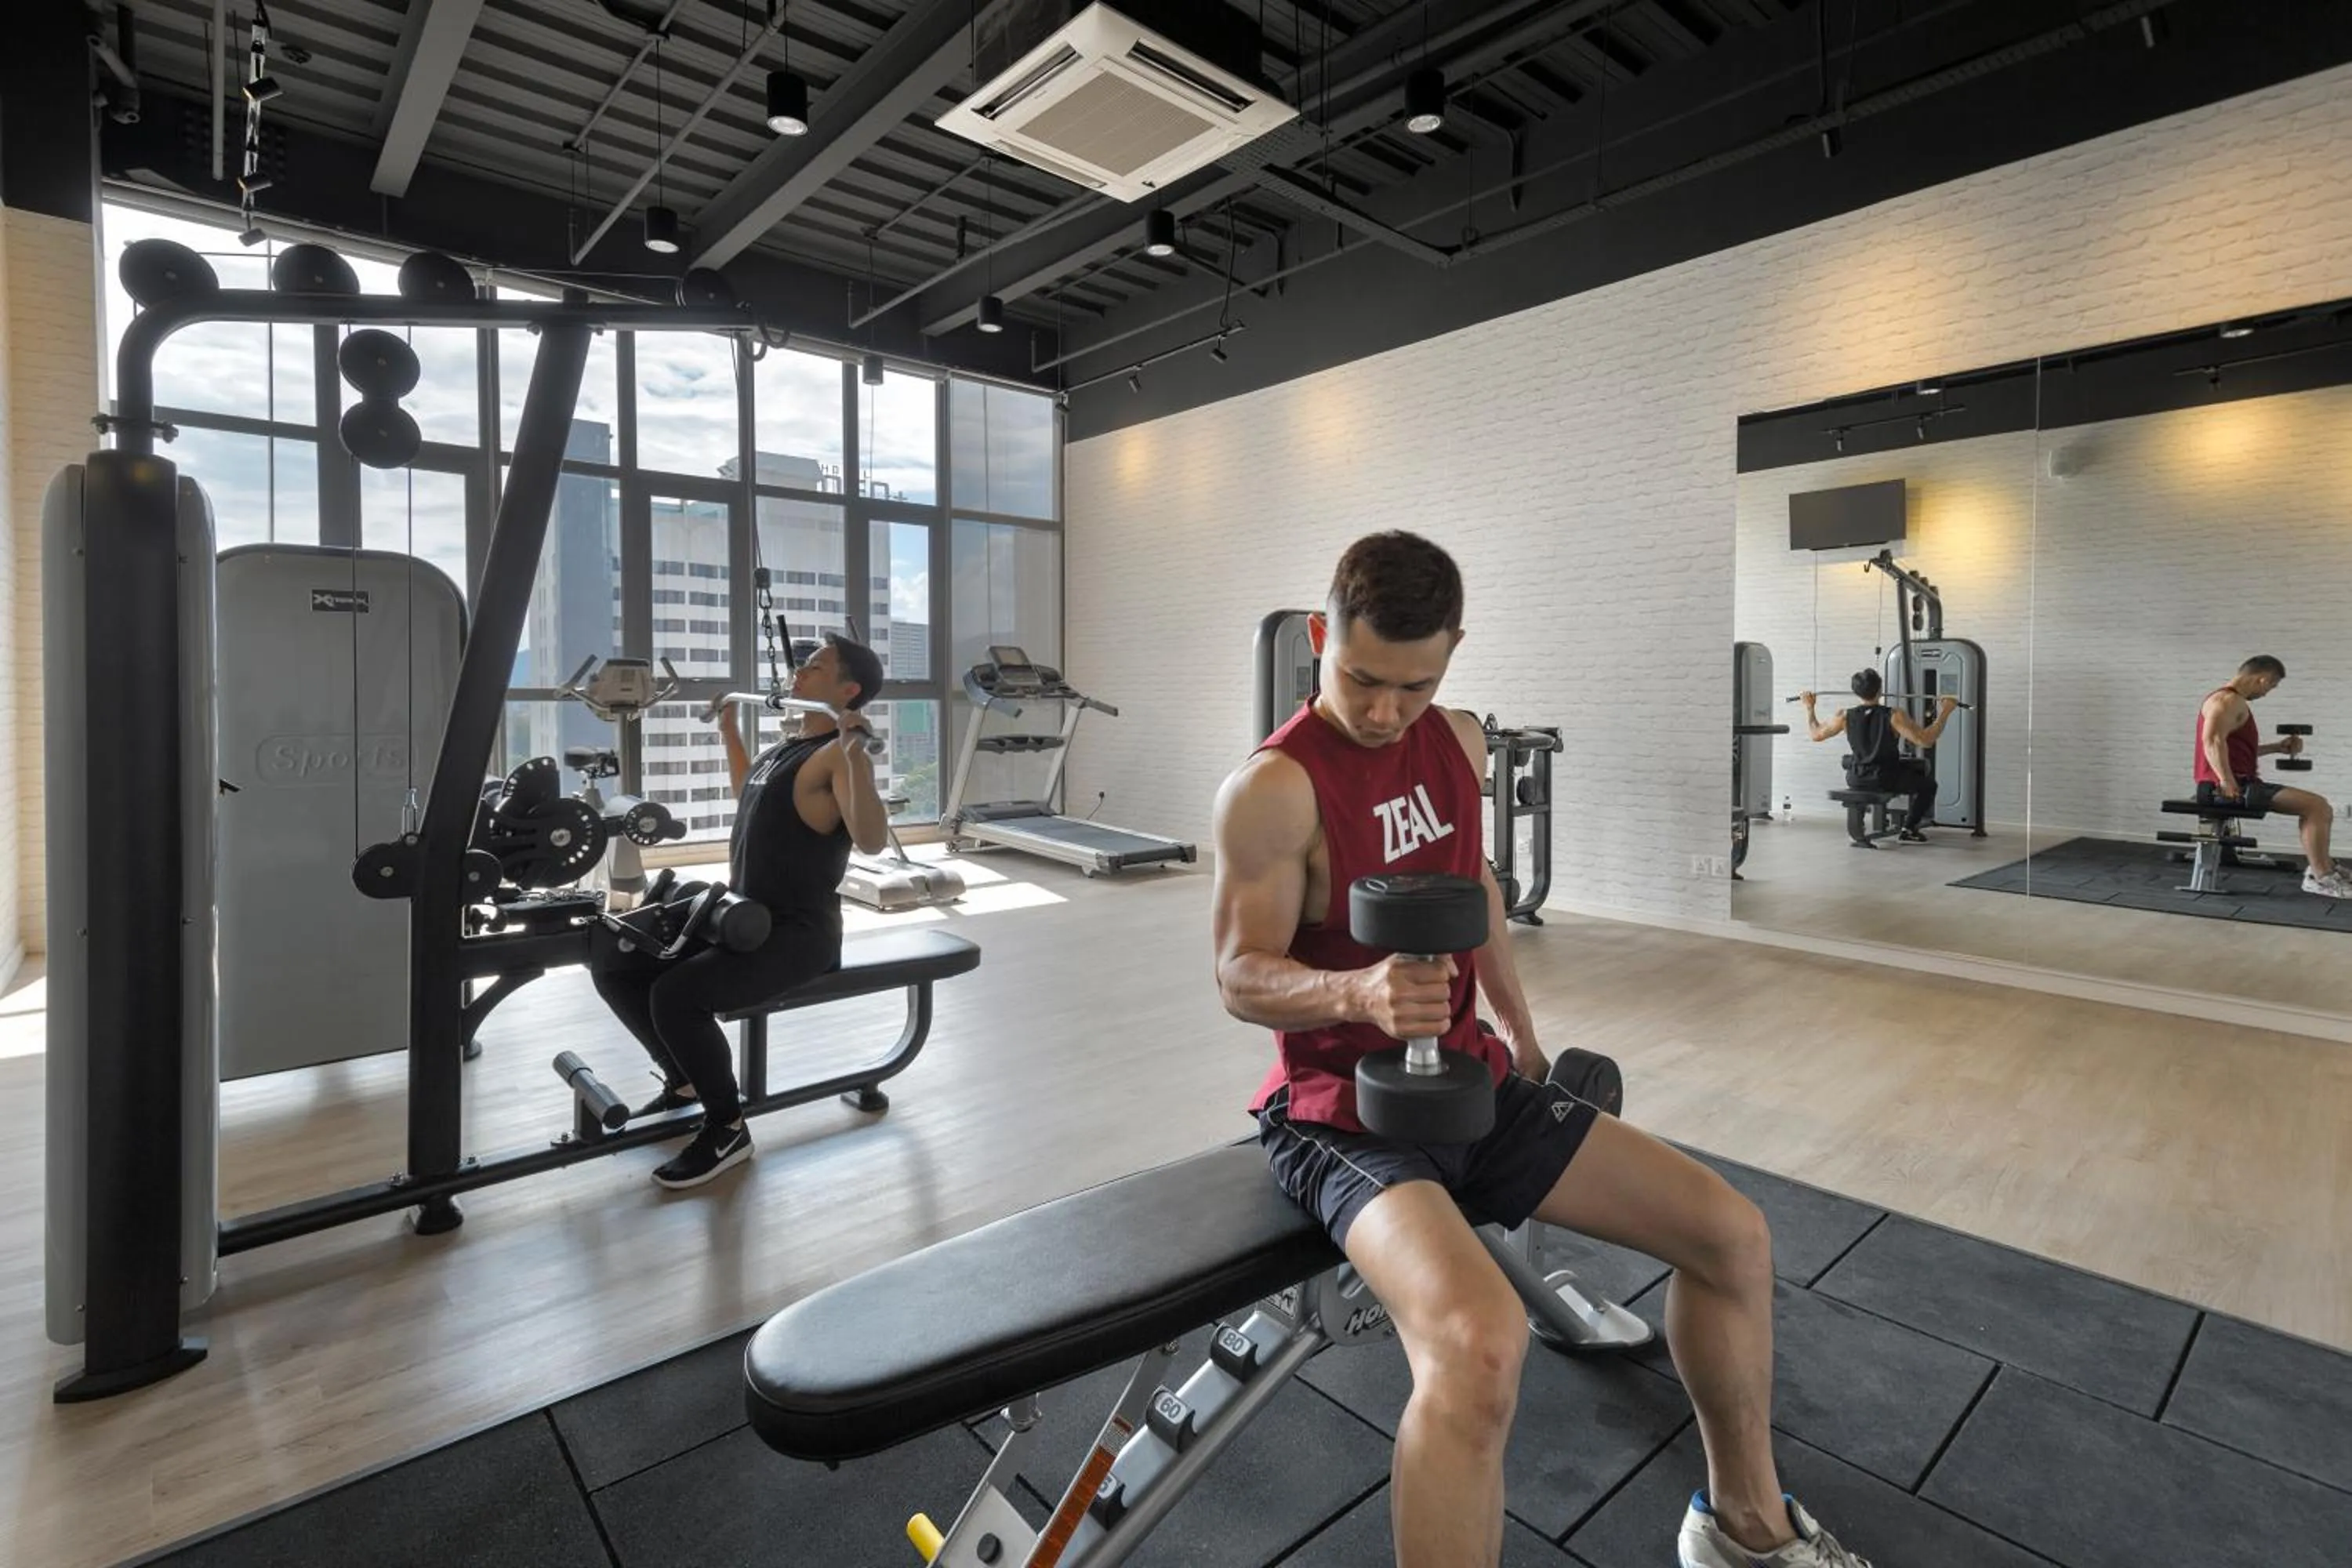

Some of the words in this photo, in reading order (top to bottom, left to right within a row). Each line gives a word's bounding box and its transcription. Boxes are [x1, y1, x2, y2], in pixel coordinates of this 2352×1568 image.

[821, 463, 872, 479] HOL
[1373, 783, 1455, 865] ZEAL
[1223, 1332, 1244, 1352] 80
[1160, 1397, 1181, 1418] 60
